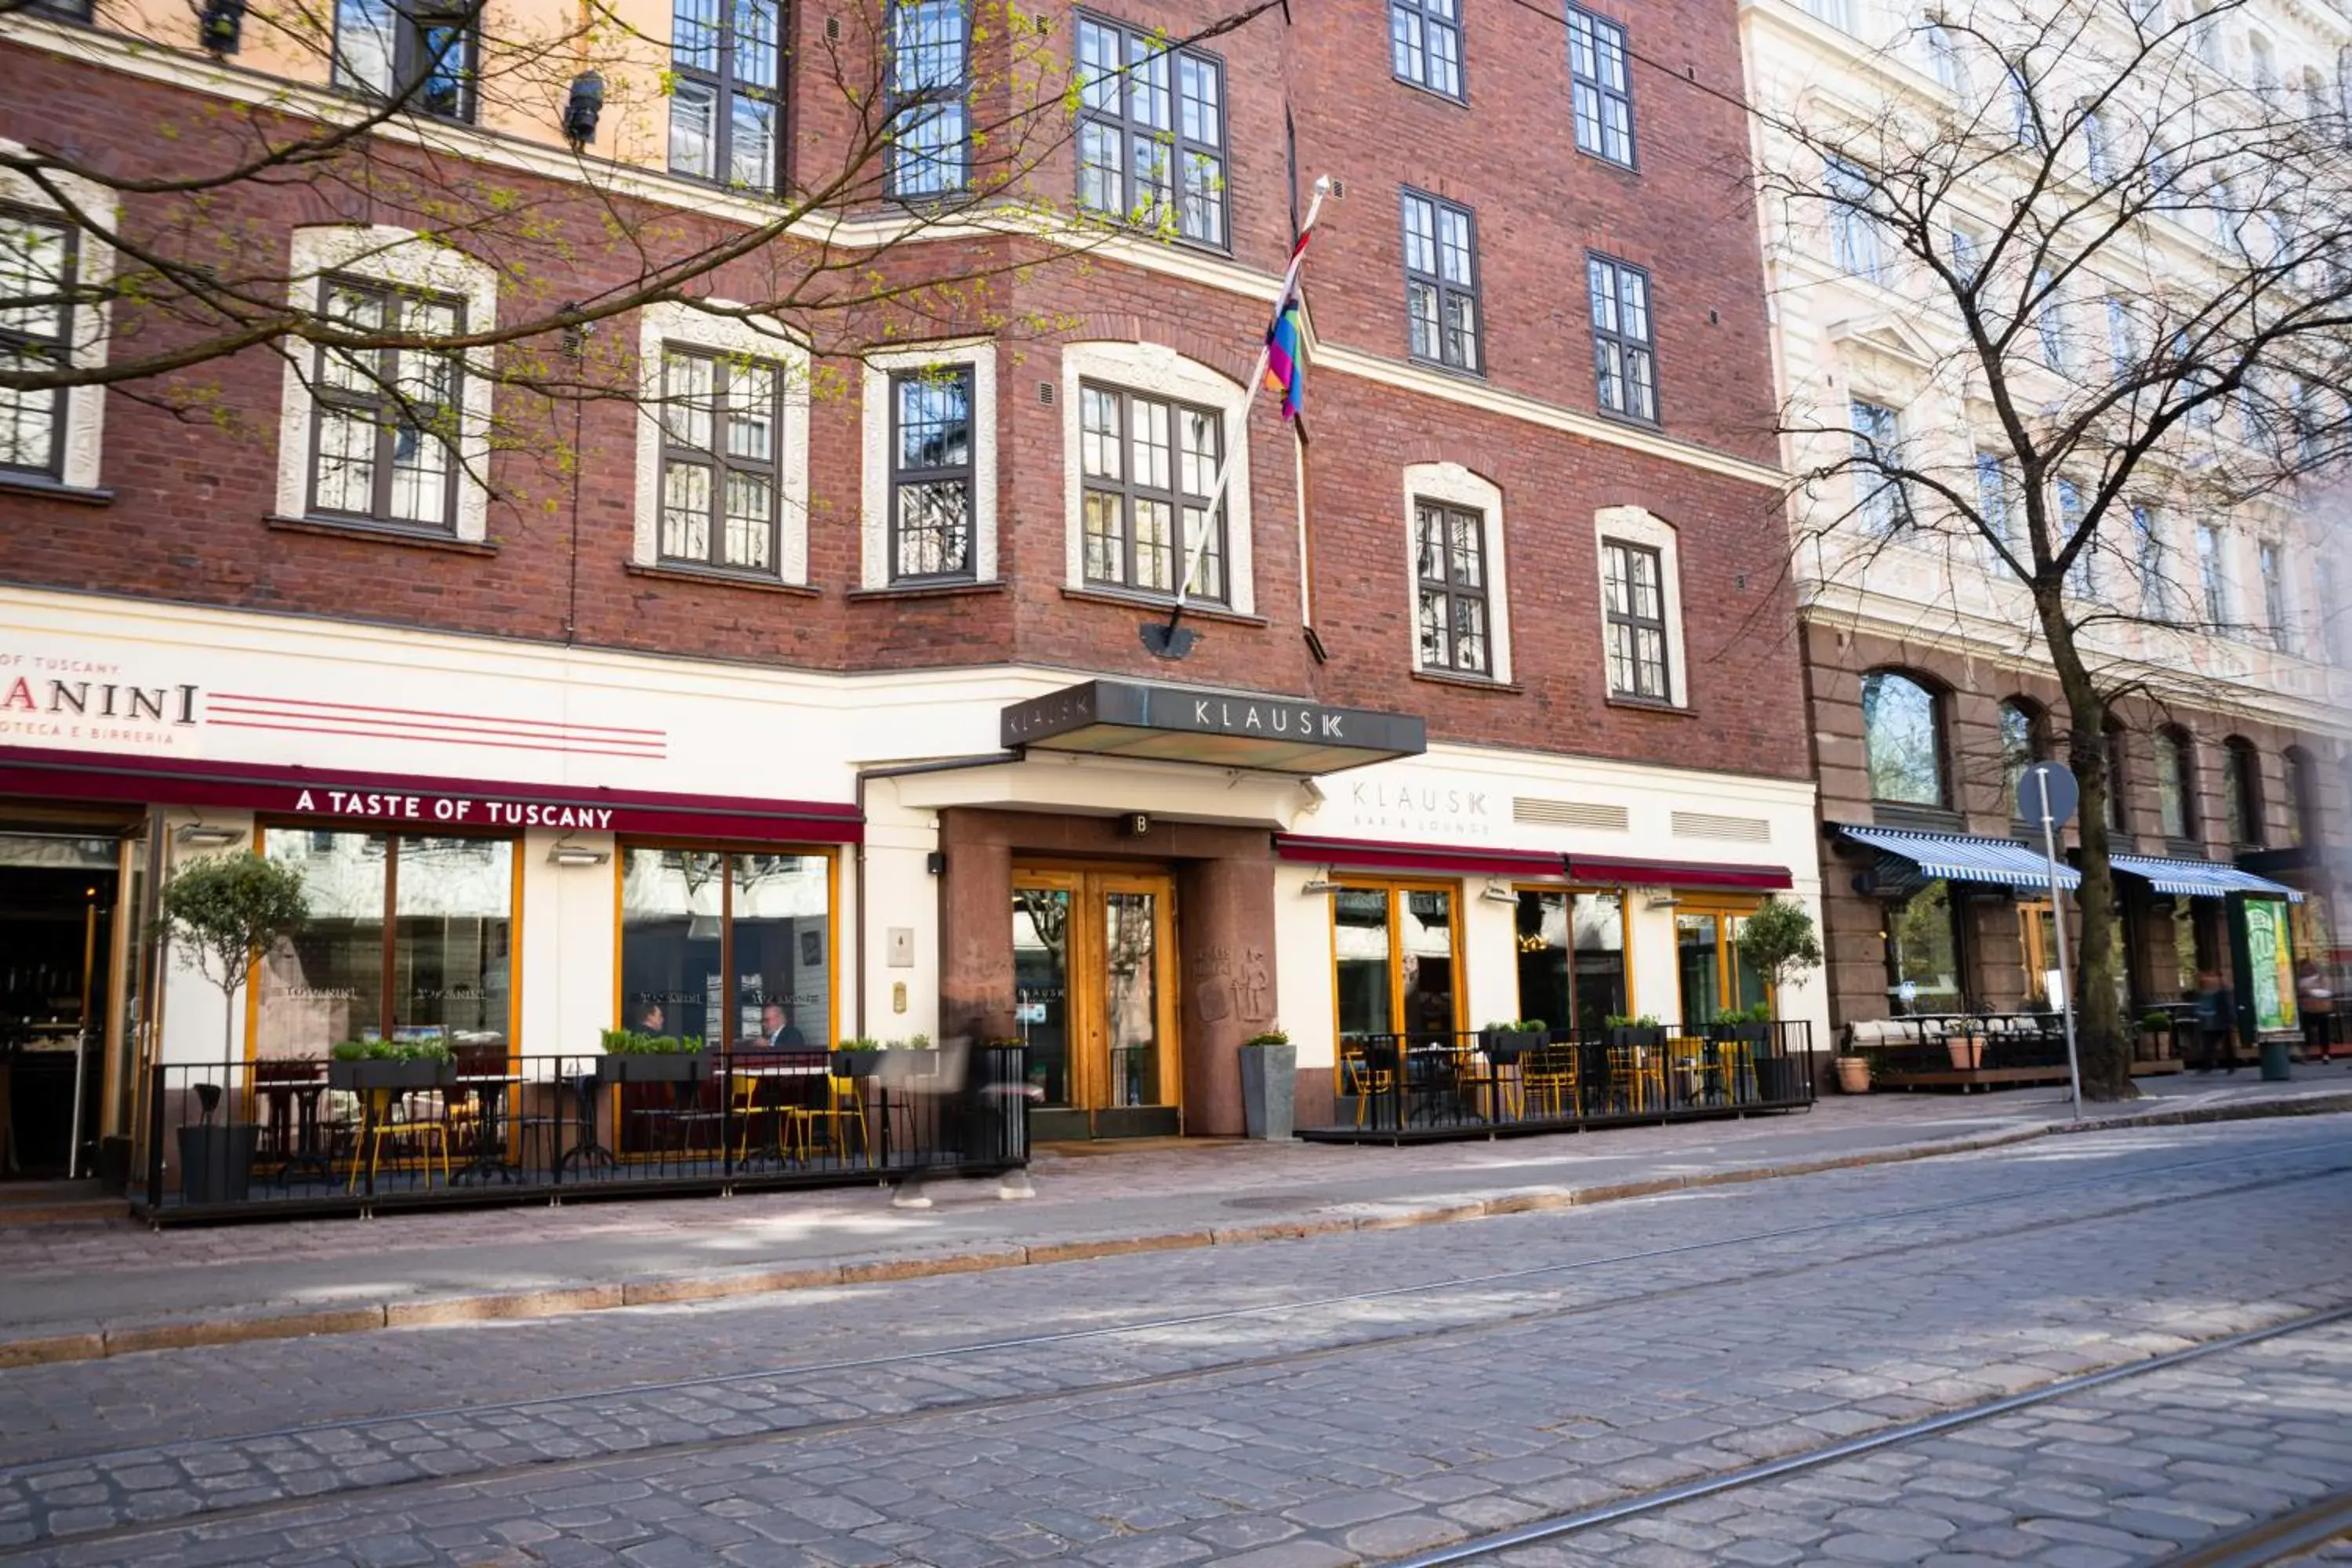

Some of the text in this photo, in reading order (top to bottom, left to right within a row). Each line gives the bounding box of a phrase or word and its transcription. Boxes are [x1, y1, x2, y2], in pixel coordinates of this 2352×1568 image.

[0, 654, 23, 666] OF
[71, 726, 81, 738] E
[90, 728, 174, 745] BIRRERIA
[296, 790, 613, 829] A TASTE OF TUSCANY
[1138, 815, 1146, 832] B
